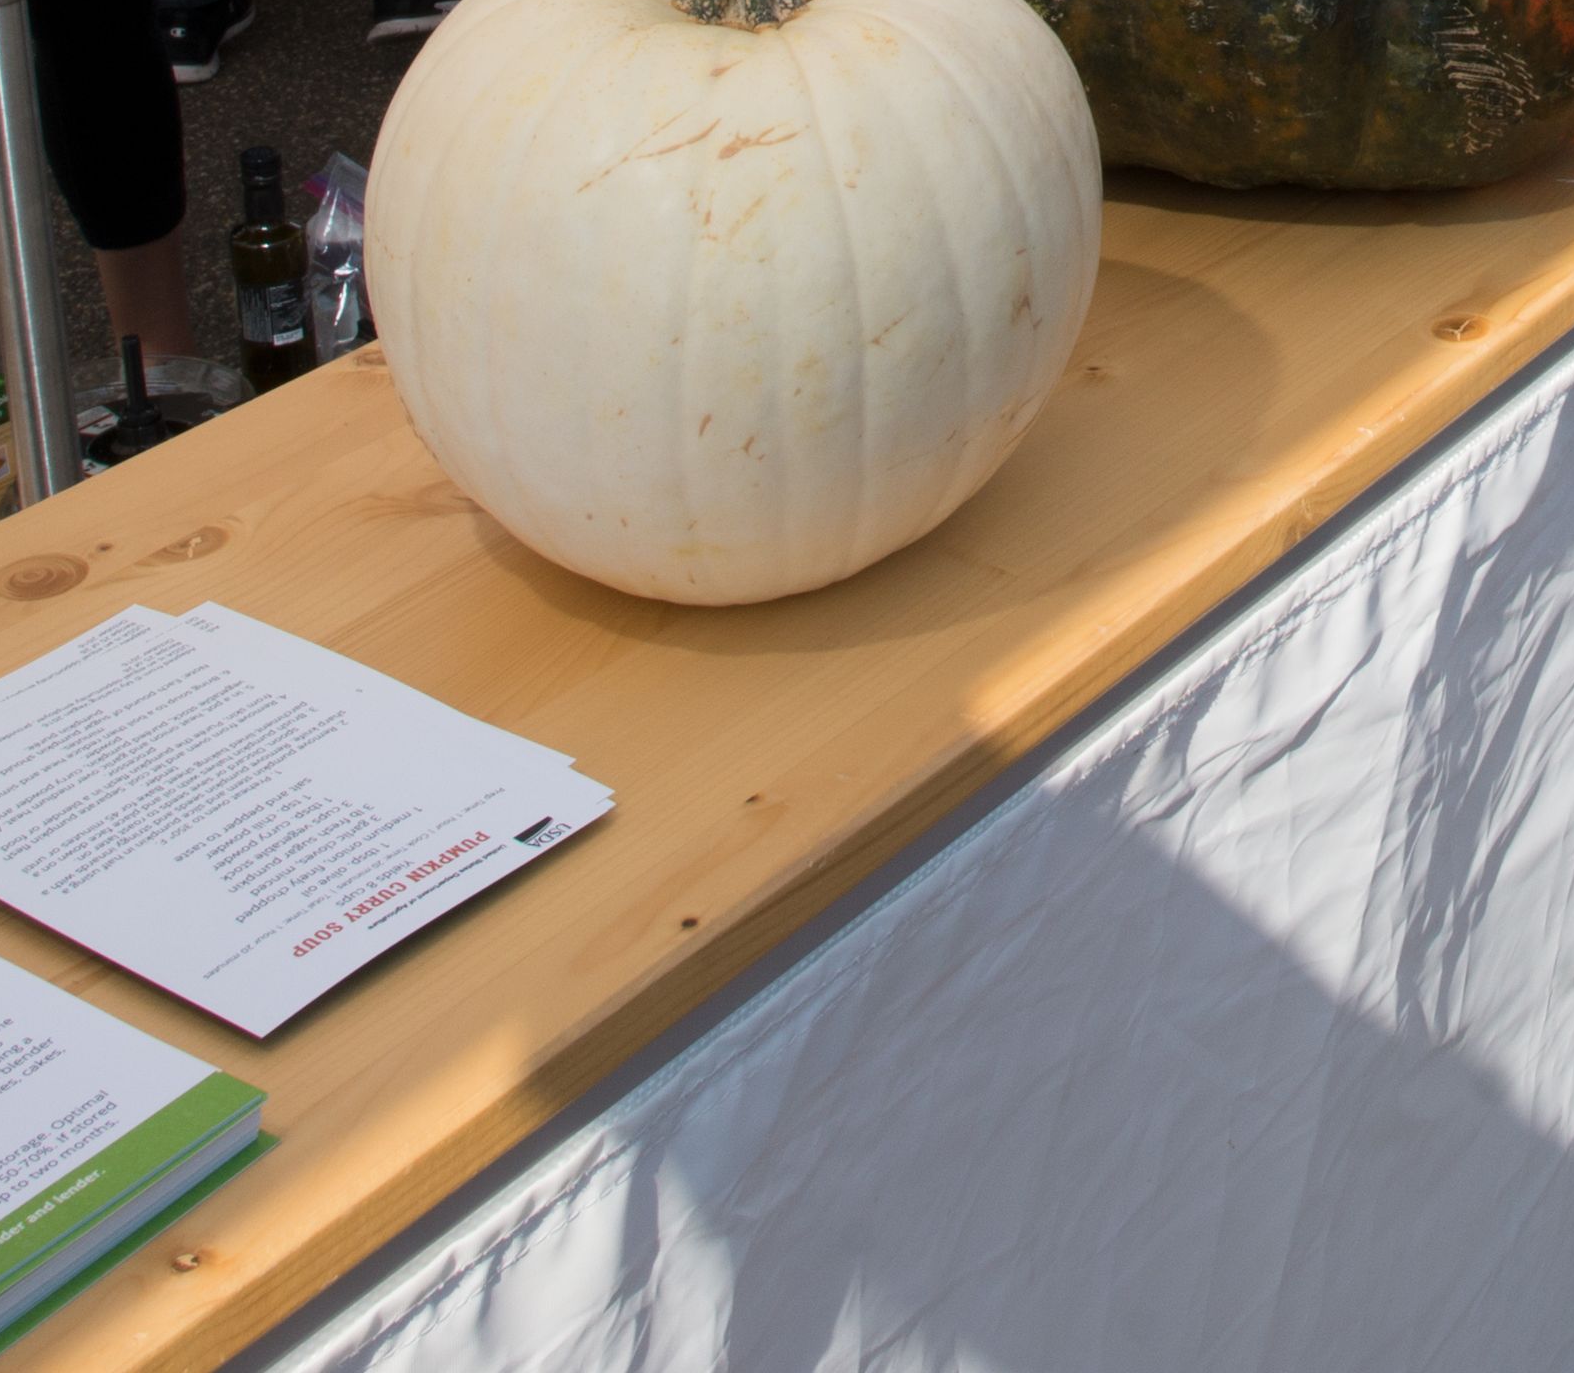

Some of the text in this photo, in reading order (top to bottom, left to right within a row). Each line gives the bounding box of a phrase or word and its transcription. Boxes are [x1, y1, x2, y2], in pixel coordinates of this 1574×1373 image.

[526, 821, 573, 849] USDA
[235, 812, 412, 923] medium onion, finely chopped
[301, 866, 347, 898] olive oil
[376, 859, 415, 882] Yields
[291, 830, 492, 959] PUMPKIN CURRY SOUP
[335, 888, 366, 907] cups
[417, 872, 460, 899] Department
[25, 1199, 55, 1225] and
[52, 1165, 108, 1209] lender.
